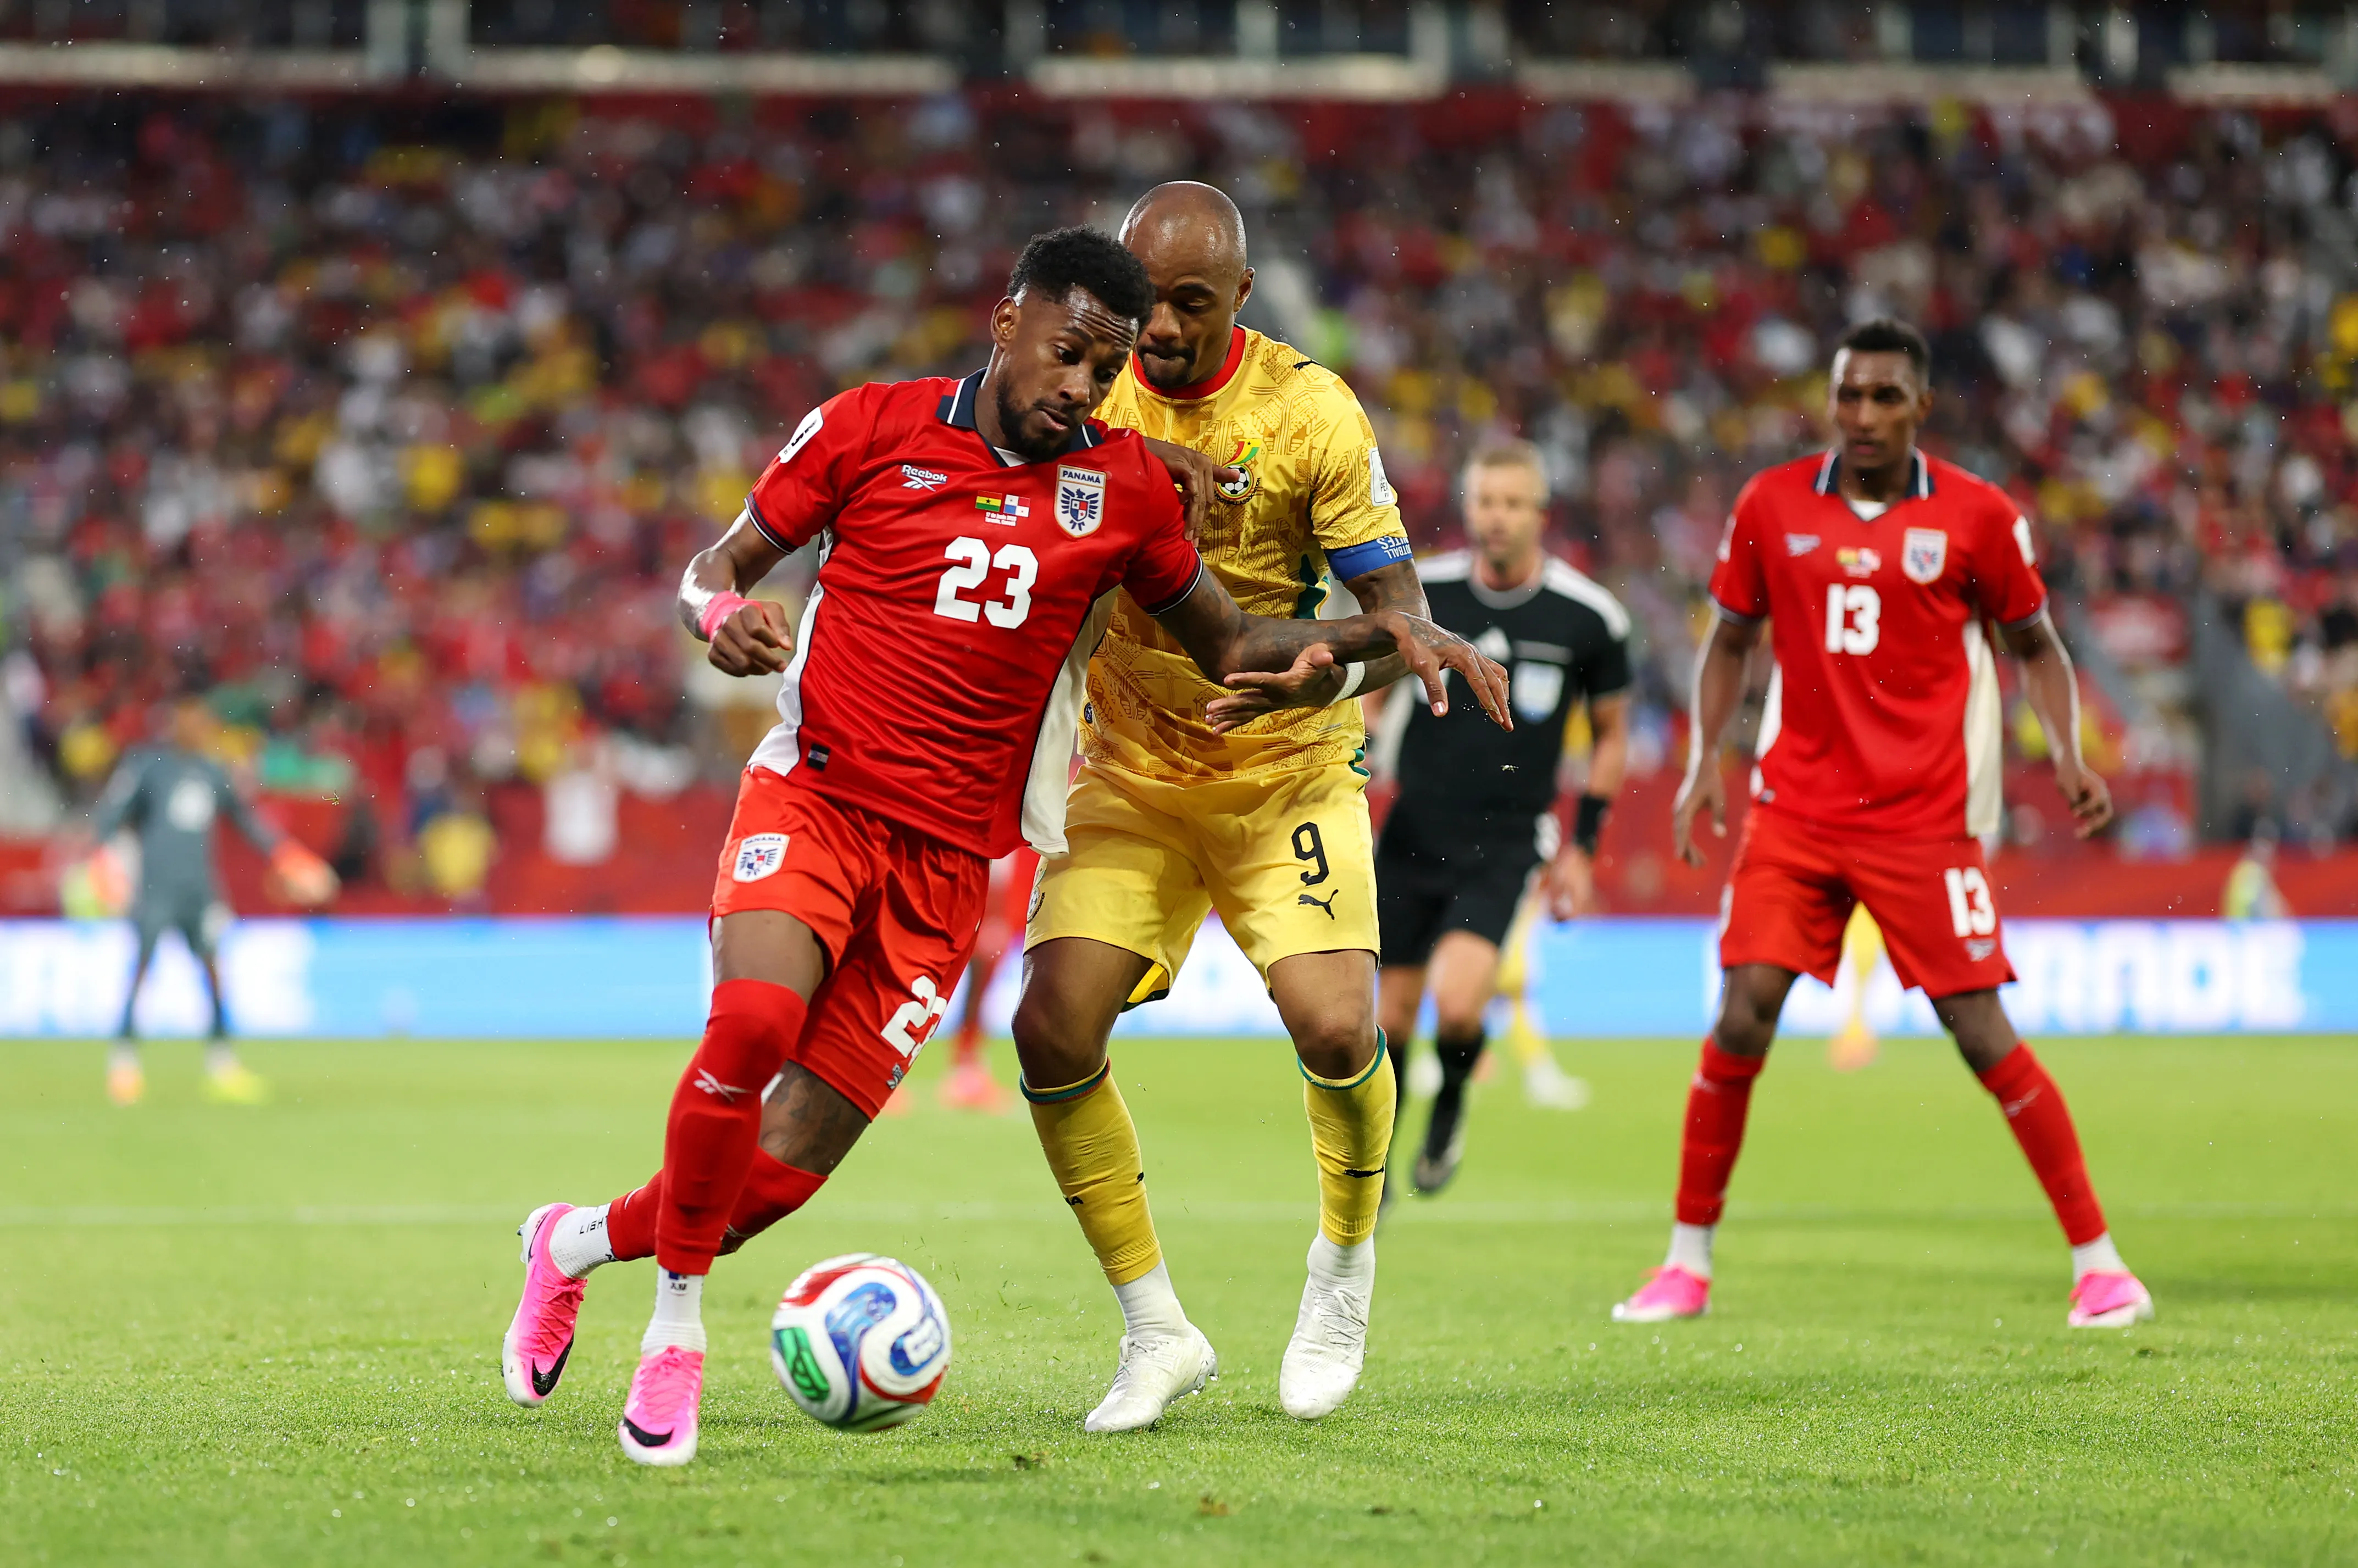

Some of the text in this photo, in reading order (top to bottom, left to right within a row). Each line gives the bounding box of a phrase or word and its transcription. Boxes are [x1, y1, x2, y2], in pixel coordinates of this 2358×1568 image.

[902, 464, 948, 482] Reebok
[1376, 535, 1410, 550] NITES
[1383, 543, 1412, 559] OTBALL
[933, 536, 1039, 630] 23
[1824, 582, 1882, 656] 13
[1291, 821, 1329, 887] 9
[1943, 866, 1996, 938] 13
